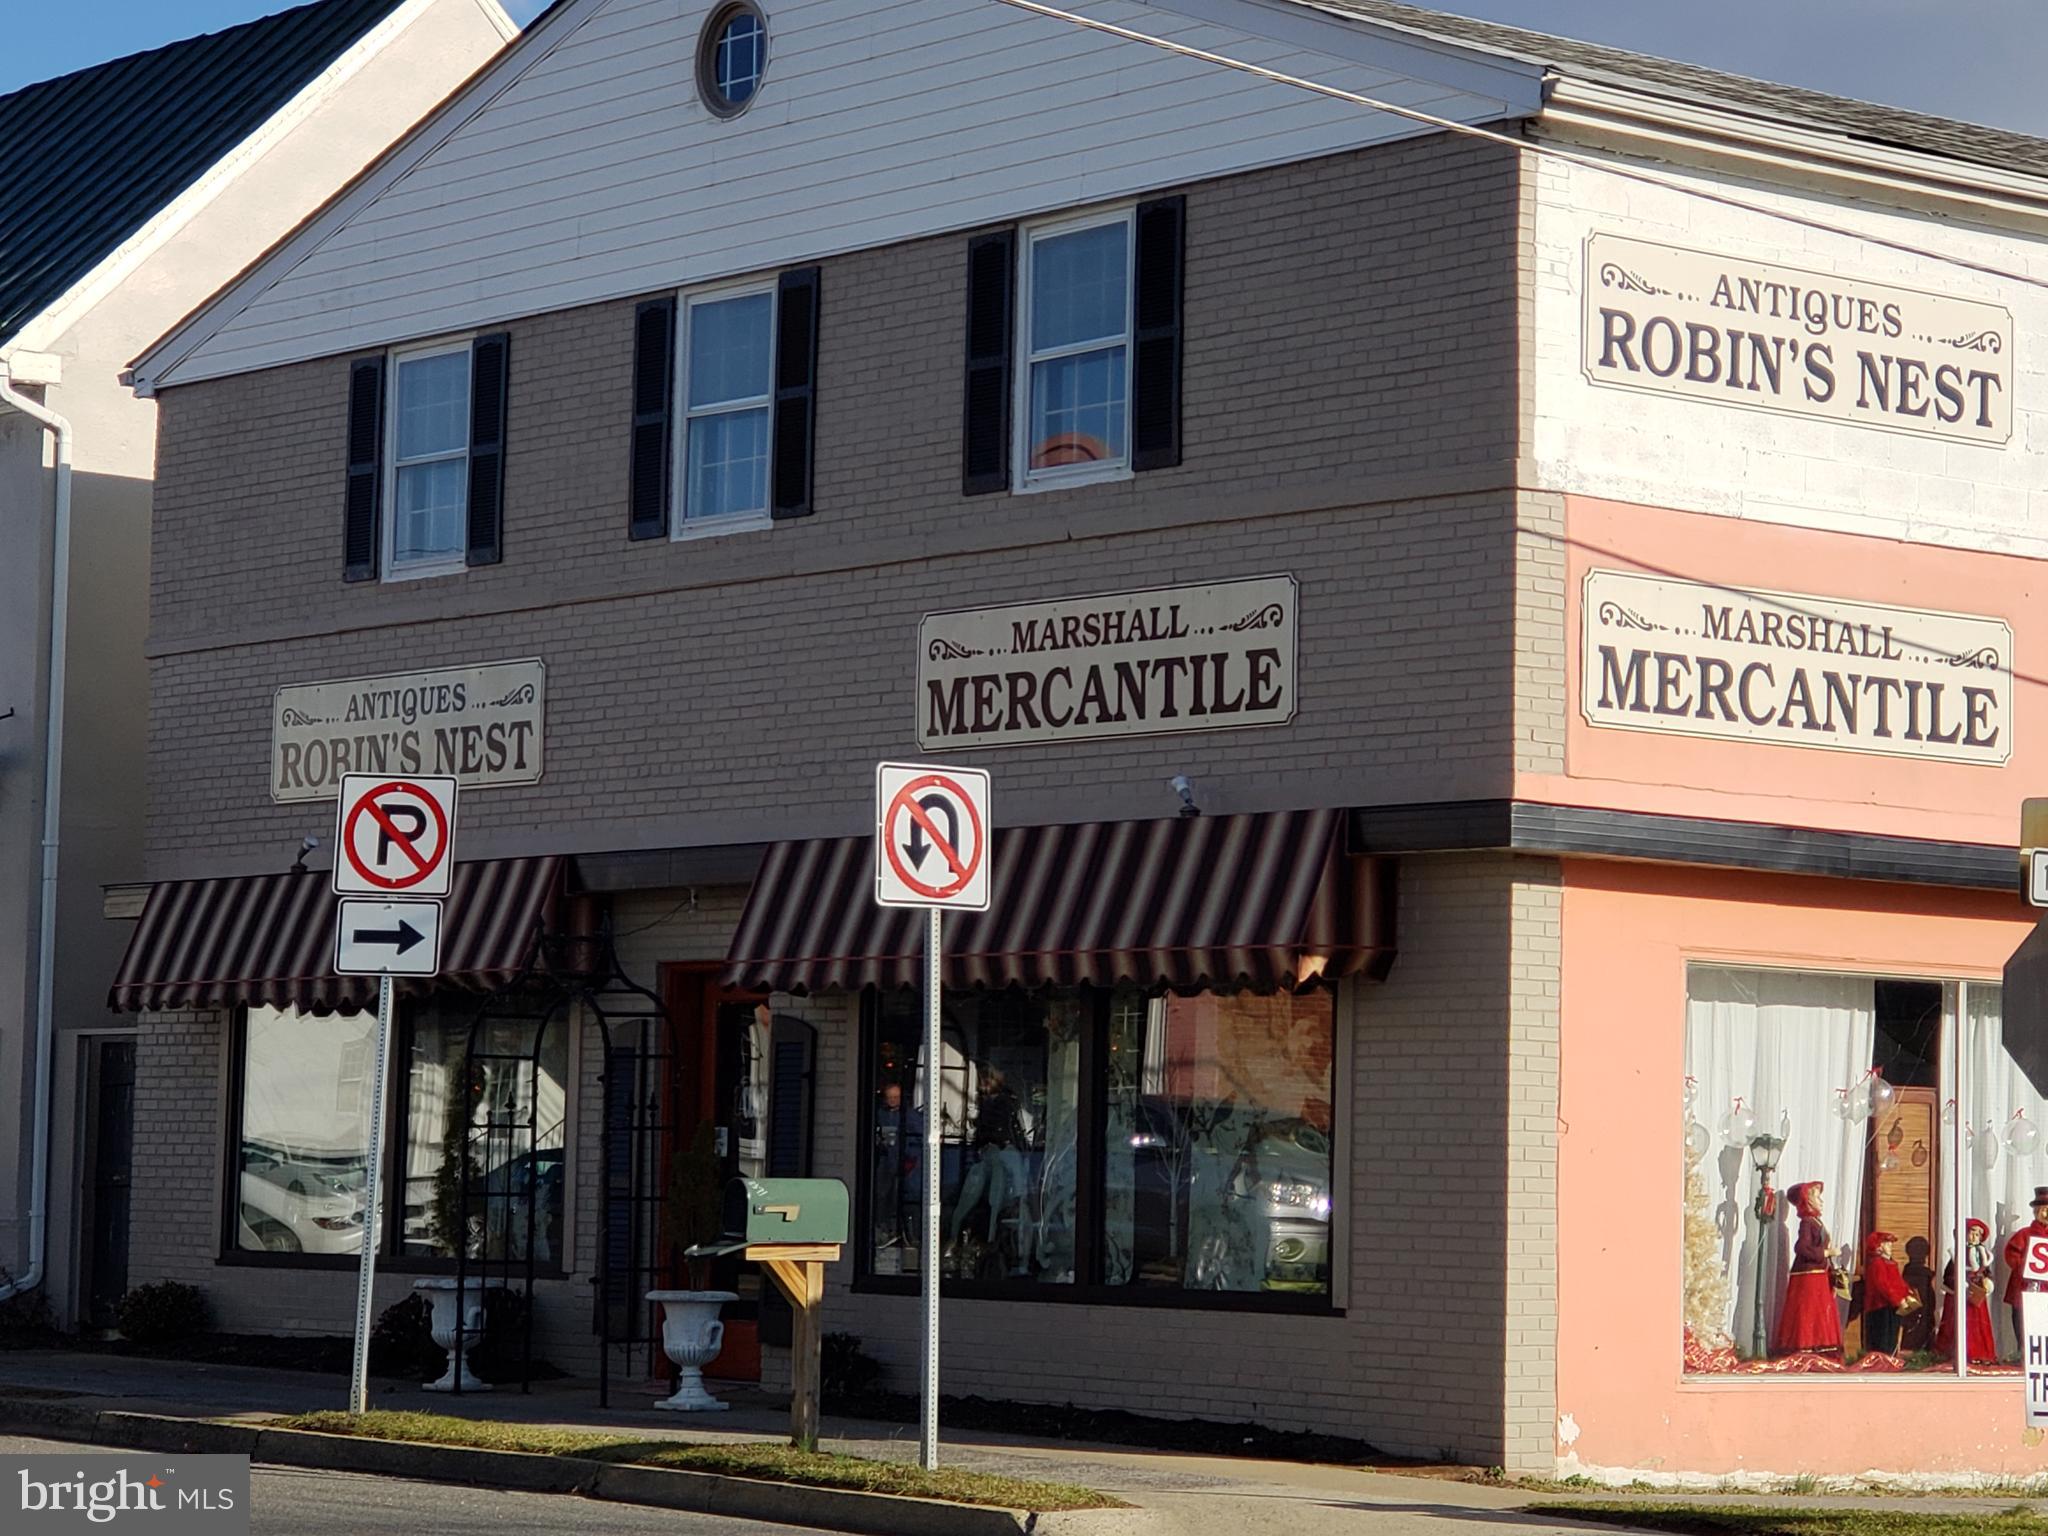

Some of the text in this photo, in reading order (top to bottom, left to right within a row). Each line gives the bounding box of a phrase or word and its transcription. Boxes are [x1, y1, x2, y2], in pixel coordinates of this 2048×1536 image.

[1710, 273, 1903, 337] ANTIQUES
[1598, 307, 2002, 428] ROBIN'S NEST
[1011, 605, 1190, 654] MARSHALL
[1701, 604, 1903, 662] MARSHALL
[344, 683, 466, 725] ANTIQUES
[927, 647, 1282, 737] MERCANTILE
[1597, 644, 1999, 748] MERCANTILE
[279, 720, 534, 789] ROBIN'S NEST
